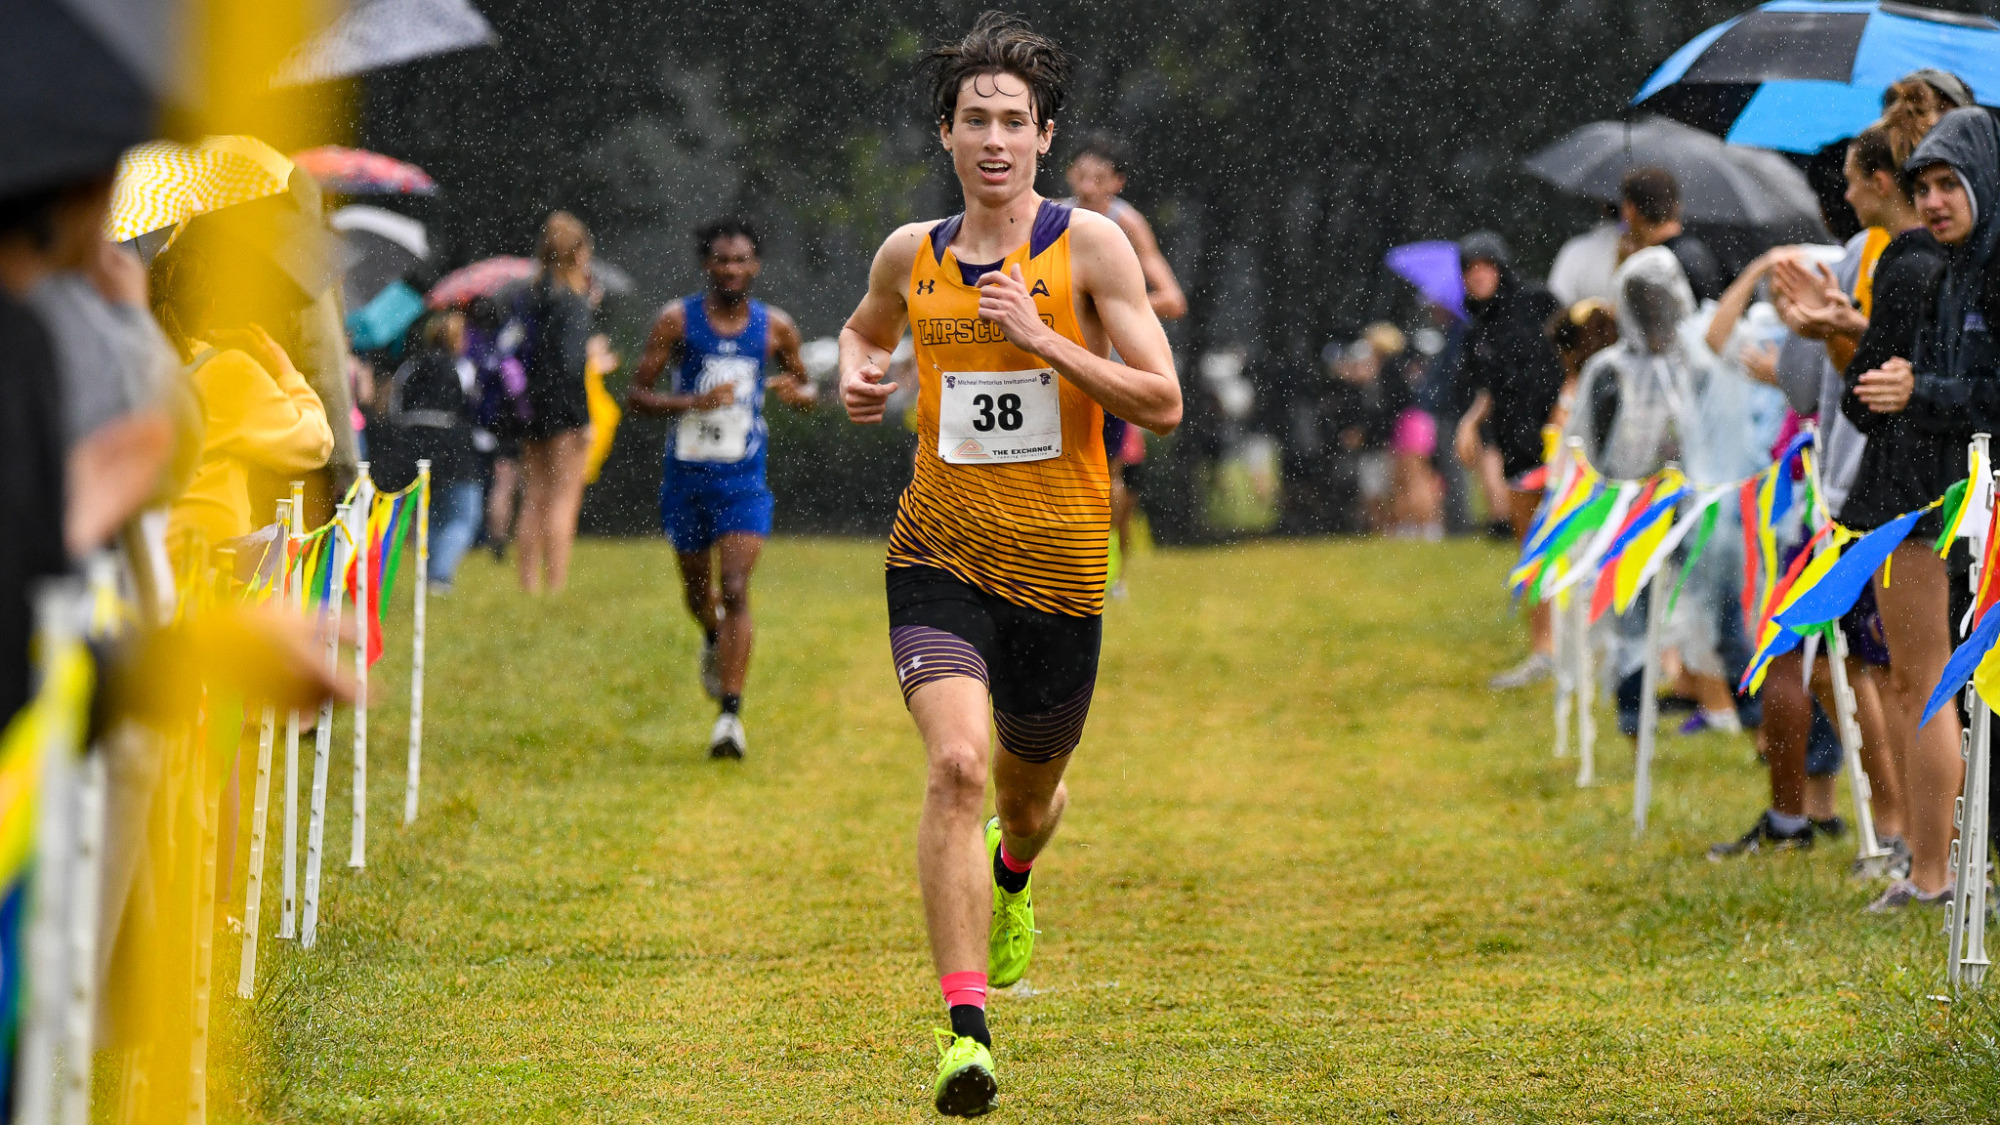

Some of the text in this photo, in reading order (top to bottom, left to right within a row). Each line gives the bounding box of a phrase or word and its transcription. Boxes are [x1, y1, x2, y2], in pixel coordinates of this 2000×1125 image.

[918, 313, 1055, 346] LIPSCOB
[973, 393, 1023, 432] 38
[1011, 445, 1053, 454] EXCHANGE
